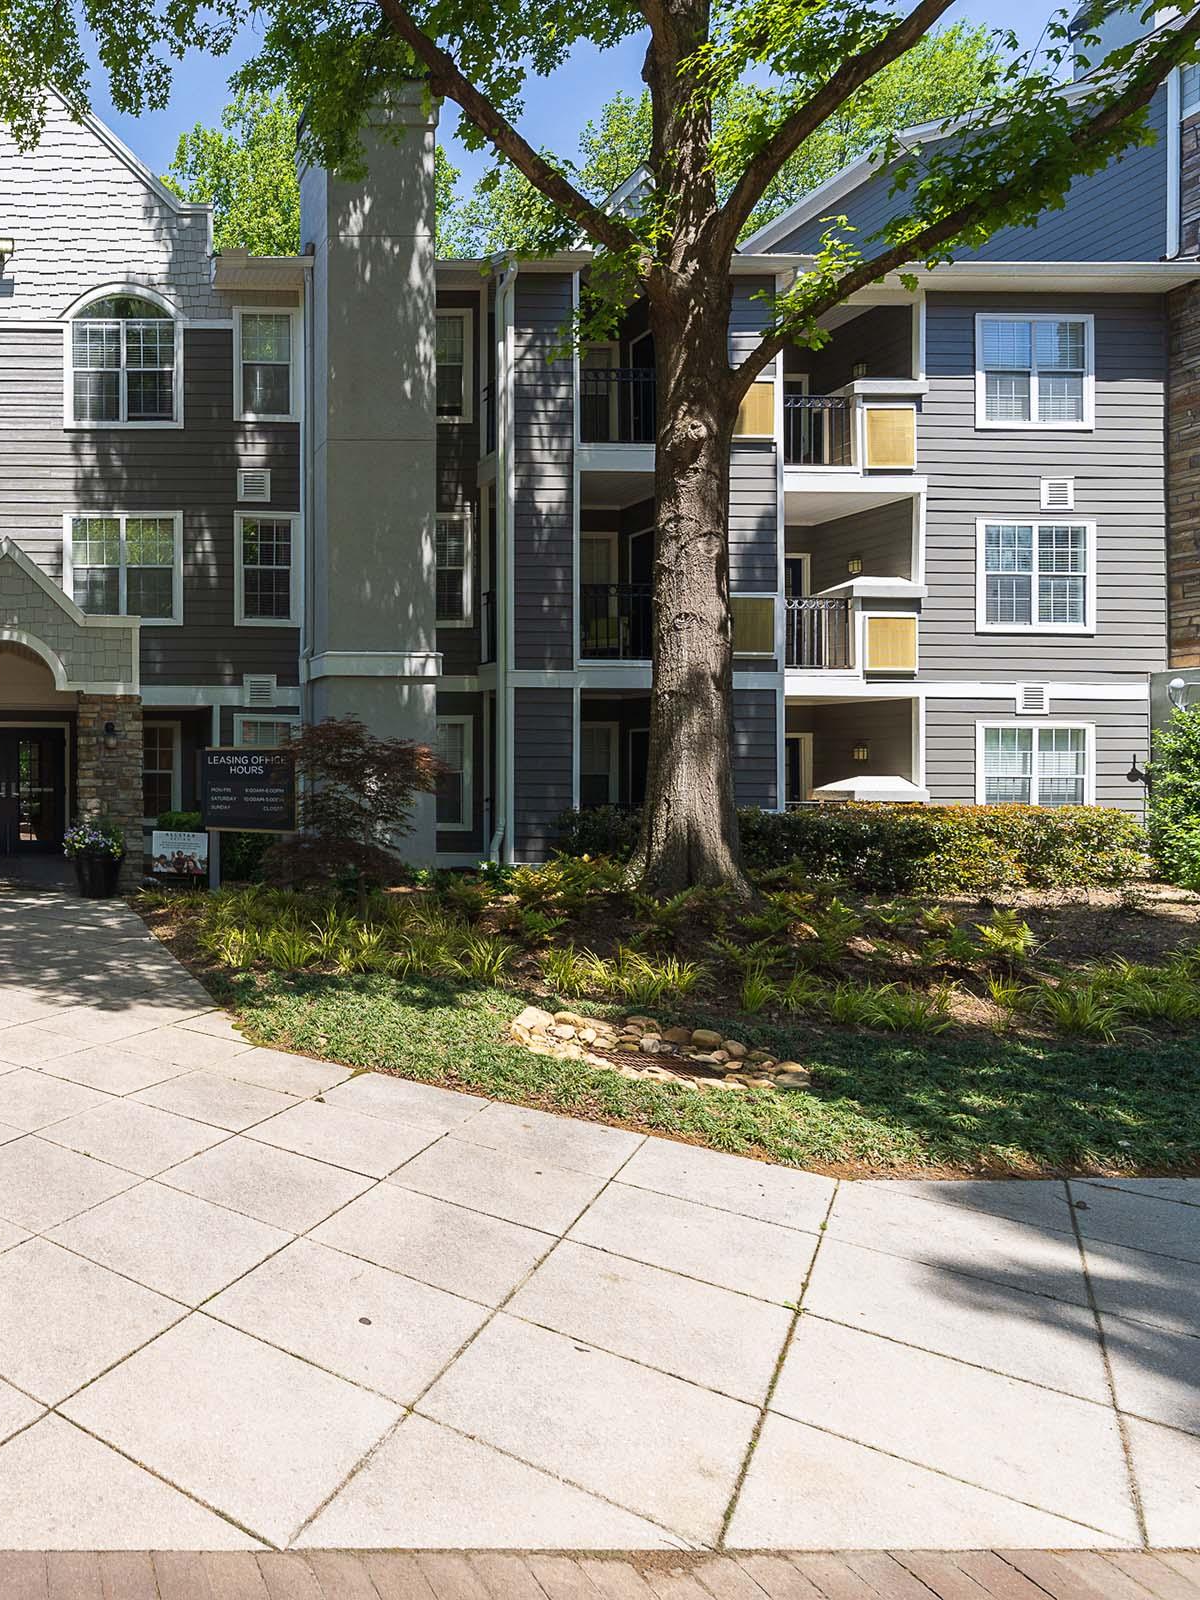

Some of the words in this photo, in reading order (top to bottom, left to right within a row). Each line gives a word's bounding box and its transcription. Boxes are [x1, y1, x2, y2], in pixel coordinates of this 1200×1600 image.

[208, 756, 248, 764] LEASING
[251, 756, 287, 765] OFFICE
[230, 766, 264, 774] HOURS
